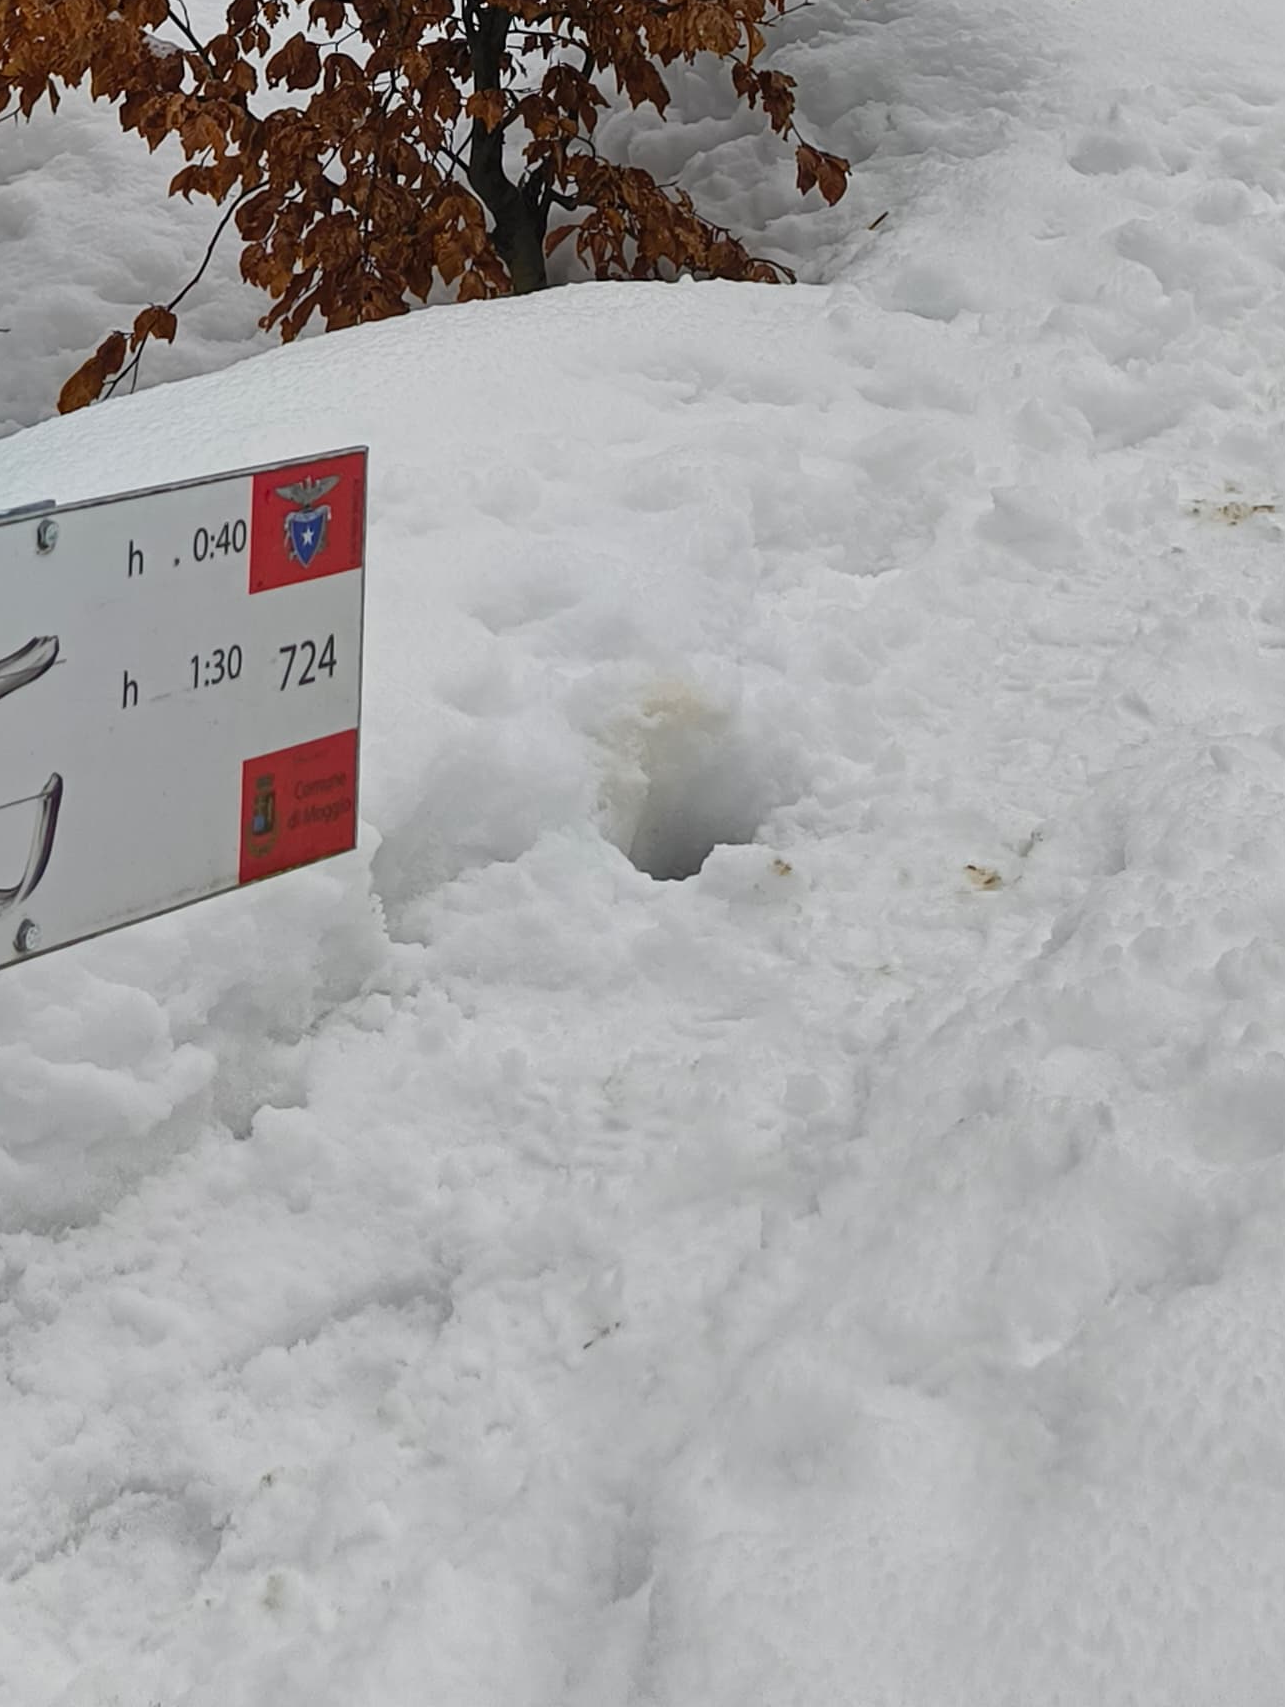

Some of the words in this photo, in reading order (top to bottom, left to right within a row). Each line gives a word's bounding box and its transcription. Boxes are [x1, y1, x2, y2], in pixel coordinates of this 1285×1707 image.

[127, 538, 144, 578] h
[192, 519, 247, 563] 0:40
[122, 669, 139, 710] h
[190, 644, 243, 690] 1:30
[278, 633, 338, 692] 724
